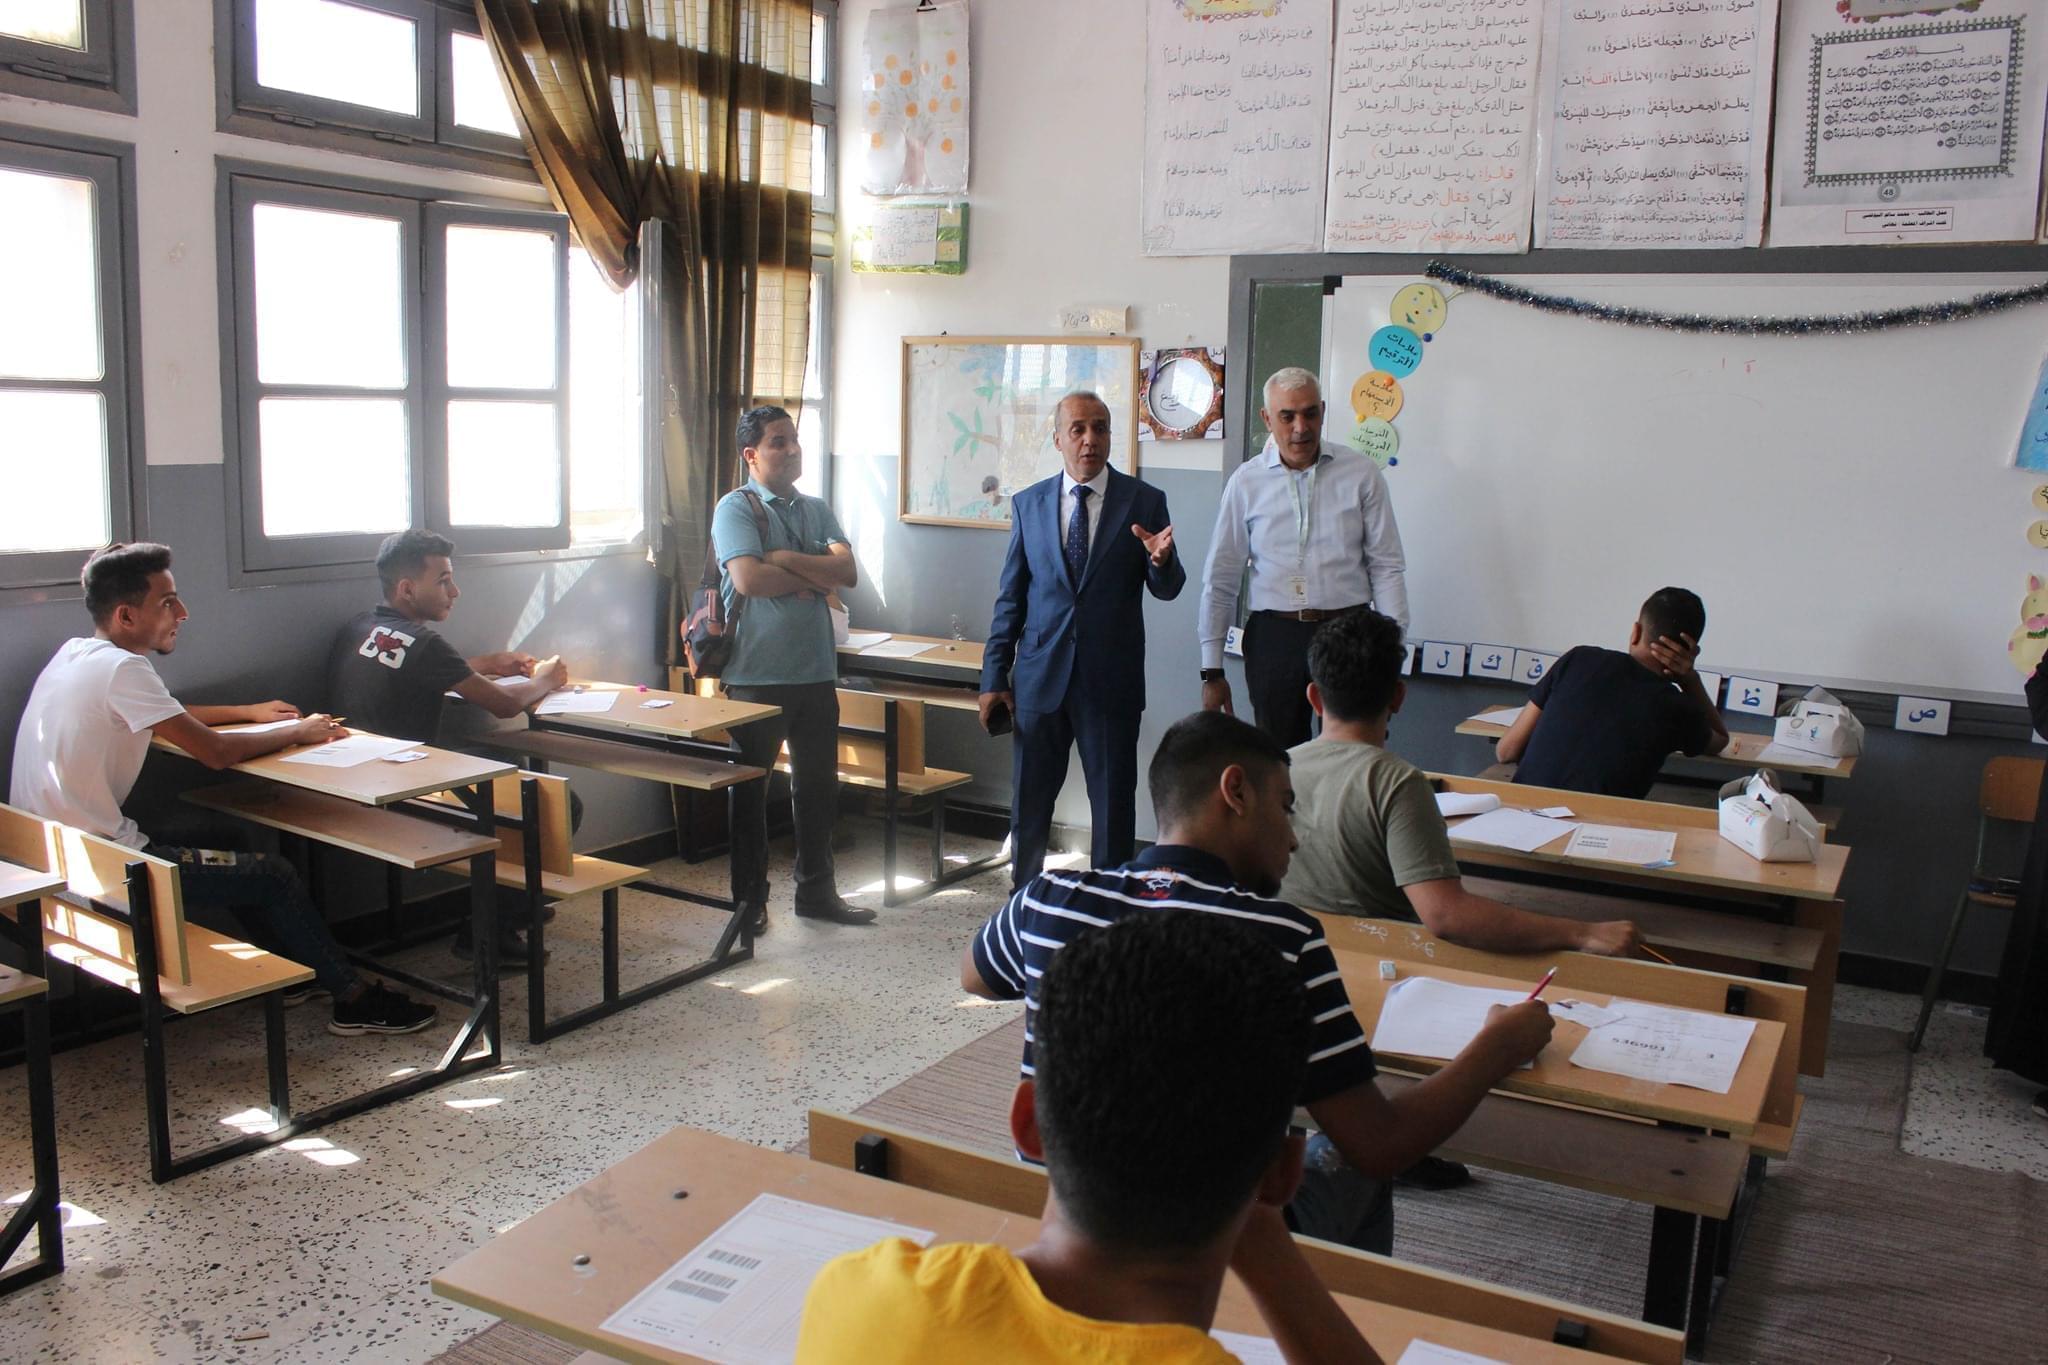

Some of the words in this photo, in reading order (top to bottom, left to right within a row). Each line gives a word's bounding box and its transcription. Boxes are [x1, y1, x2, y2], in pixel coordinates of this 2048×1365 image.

[1883, 188, 1894, 196] 48
[1437, 650, 1451, 669] ل
[1481, 653, 1502, 671] ك
[1527, 657, 1544, 679] ق
[1907, 707, 1938, 724] ص
